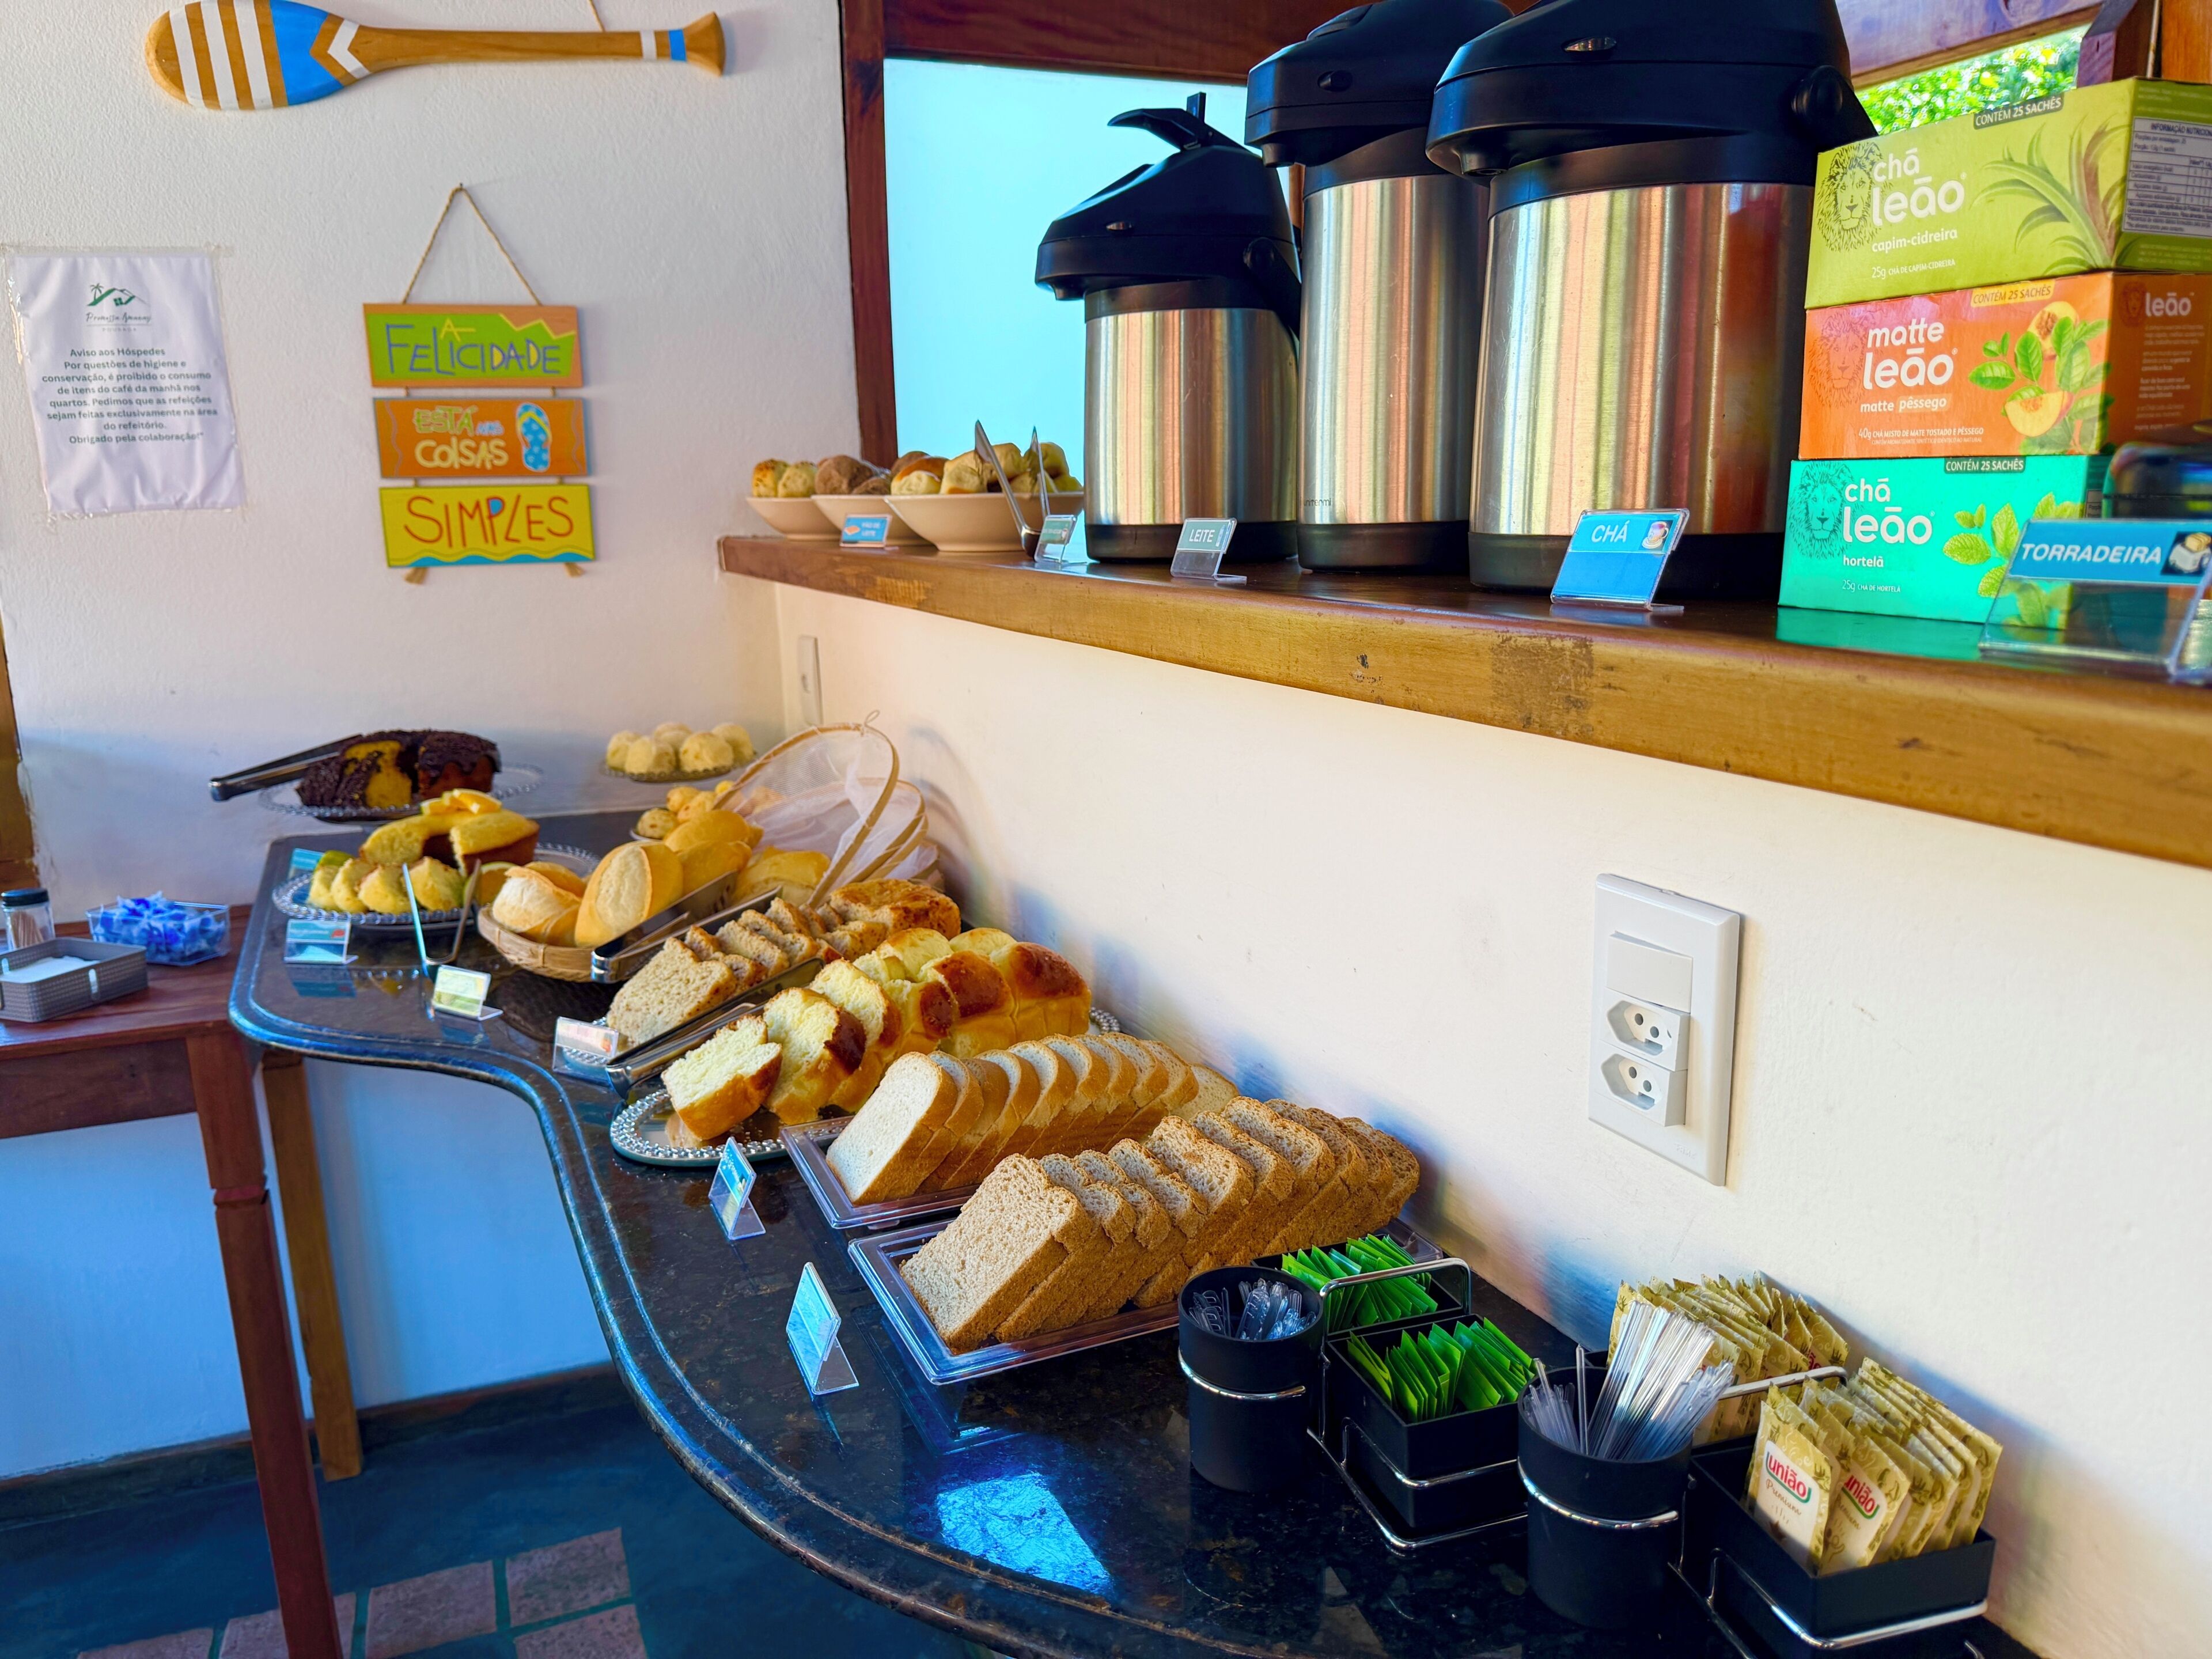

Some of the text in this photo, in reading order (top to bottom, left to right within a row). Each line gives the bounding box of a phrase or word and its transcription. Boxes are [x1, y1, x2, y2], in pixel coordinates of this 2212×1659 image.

[1975, 96, 2062, 126] CONTÉM 25 SACHÊS
[1872, 175, 1965, 228] leão
[1872, 228, 1958, 253] capim-cidreira
[1872, 259, 1956, 280] 25g CHÁ DE CAPIM-CIDREIRA
[1973, 285, 2051, 304] CONTÉM 25 SACHÊS
[440, 317, 476, 342] A
[1868, 317, 1944, 348] matte
[70, 348, 96, 357] Aviso
[117, 347, 165, 358] Hóspedes
[385, 323, 561, 376] FELICIDADE
[64, 361, 81, 370] Por
[84, 360, 127, 371] questões
[129, 360, 142, 369] de
[143, 359, 179, 370] higiene
[1863, 347, 1954, 390] leão
[42, 373, 107, 384] conservação,
[108, 373, 114, 381] é
[116, 373, 158, 382] proibido
[168, 372, 211, 380] consumo
[58, 383, 201, 395] de itens do café da manhã nos
[92, 397, 133, 407] Pedimos
[135, 398, 154, 407] que
[168, 396, 212, 406] refeições
[1860, 396, 1947, 414] matte pêssego
[47, 408, 218, 421] sejam feitas exclusivamente na área
[104, 422, 116, 431] do
[1858, 427, 1872, 441] 40g
[1872, 429, 1883, 438] CHÁ
[1883, 430, 1902, 438] MISTO
[1902, 429, 1910, 437] DE
[1926, 428, 1952, 436] TOSTADO
[1957, 426, 1984, 435] PÊSSEGO
[69, 434, 113, 445] Obrigado
[115, 434, 137, 444] pela
[415, 435, 509, 470] COISAS
[1946, 458, 2024, 471] CONTÉM 25 SACHÊS
[404, 493, 575, 549] SIMPLES
[1843, 506, 1933, 546] leão
[1189, 529, 1215, 543] LEITE
[1590, 520, 1630, 543] CHÁ
[1843, 555, 1884, 568] hortelã
[2021, 542, 2162, 565] TORRADEIRA
[1842, 579, 1855, 593] 25g
[1768, 1455, 1807, 1498] união
[1766, 1478, 1802, 1516] Premium
